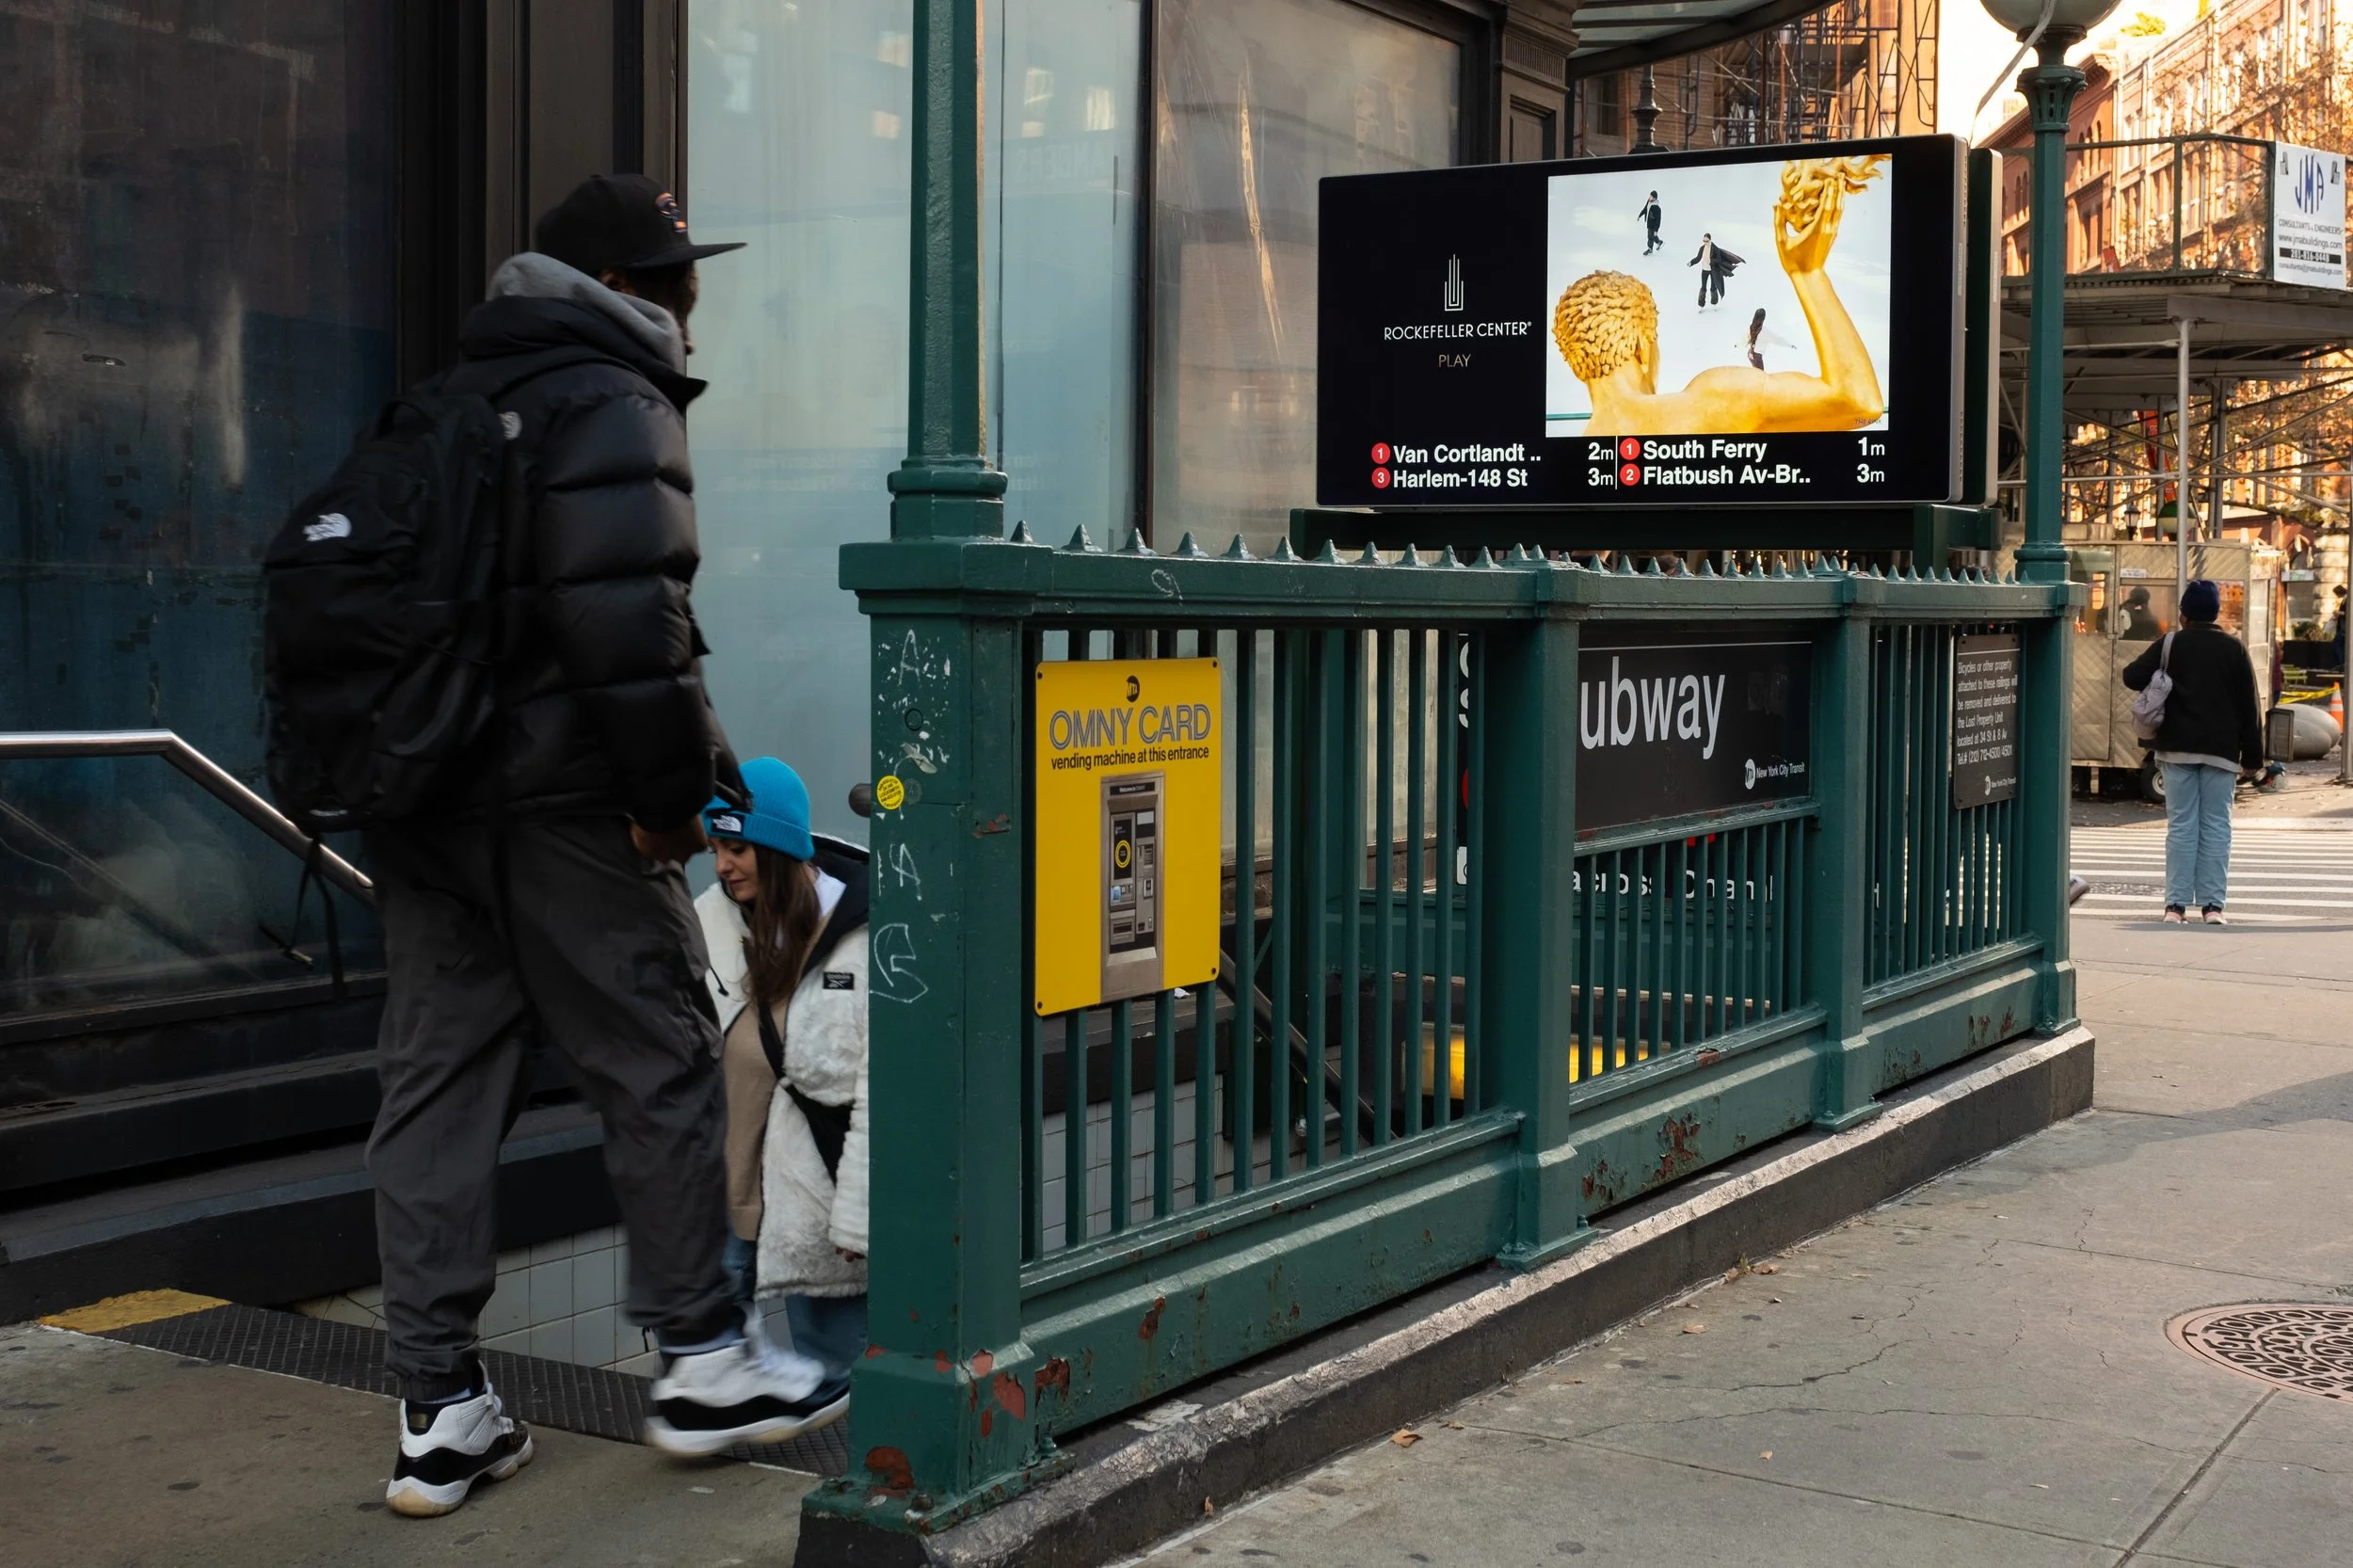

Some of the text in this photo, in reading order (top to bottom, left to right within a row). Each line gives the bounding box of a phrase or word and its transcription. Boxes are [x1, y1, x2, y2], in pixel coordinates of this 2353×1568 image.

[2295, 154, 2325, 215] JMA
[2279, 218, 2310, 232] CONSULTANTS
[2314, 223, 2342, 235] ENGINEERS
[2279, 234, 2343, 249] www.jmabuildings.com
[1384, 323, 1474, 341] ROCKEFELLER
[1438, 354, 1471, 368] PLAY
[1393, 444, 1428, 464] Van
[1433, 442, 1526, 464] Cortlandt
[1588, 441, 1614, 461] 2m
[1642, 440, 1705, 460] South
[1711, 439, 1768, 462] Ferry
[1857, 437, 1885, 456] 1m
[1393, 469, 1502, 488] Harlem-148
[1507, 468, 1529, 488] St
[1588, 467, 1614, 487] 3m
[1642, 465, 1734, 485] Flatbush
[1857, 463, 1885, 483] 3m
[1958, 659, 2012, 676] Bicycles or other property
[1958, 680, 1977, 692] attached
[1977, 679, 1983, 690] to
[1983, 678, 1995, 689] these
[1995, 676, 2010, 690] railings
[1580, 656, 1726, 760] ubway
[1958, 693, 2017, 711] be removed and delivered to
[1049, 704, 1211, 750] OMNY CARD
[1966, 715, 1976, 728] Lost
[1977, 712, 1994, 728] Property
[1994, 711, 2004, 724] Unit
[1957, 733, 1974, 746] located
[1974, 732, 1979, 744] at
[1979, 730, 1986, 744] 34
[1051, 744, 1209, 771] vending machine at this entrance
[1756, 767, 1768, 778] New
[1768, 764, 1779, 777] York
[1779, 764, 1788, 777] City
[1789, 762, 1805, 775] Transit
